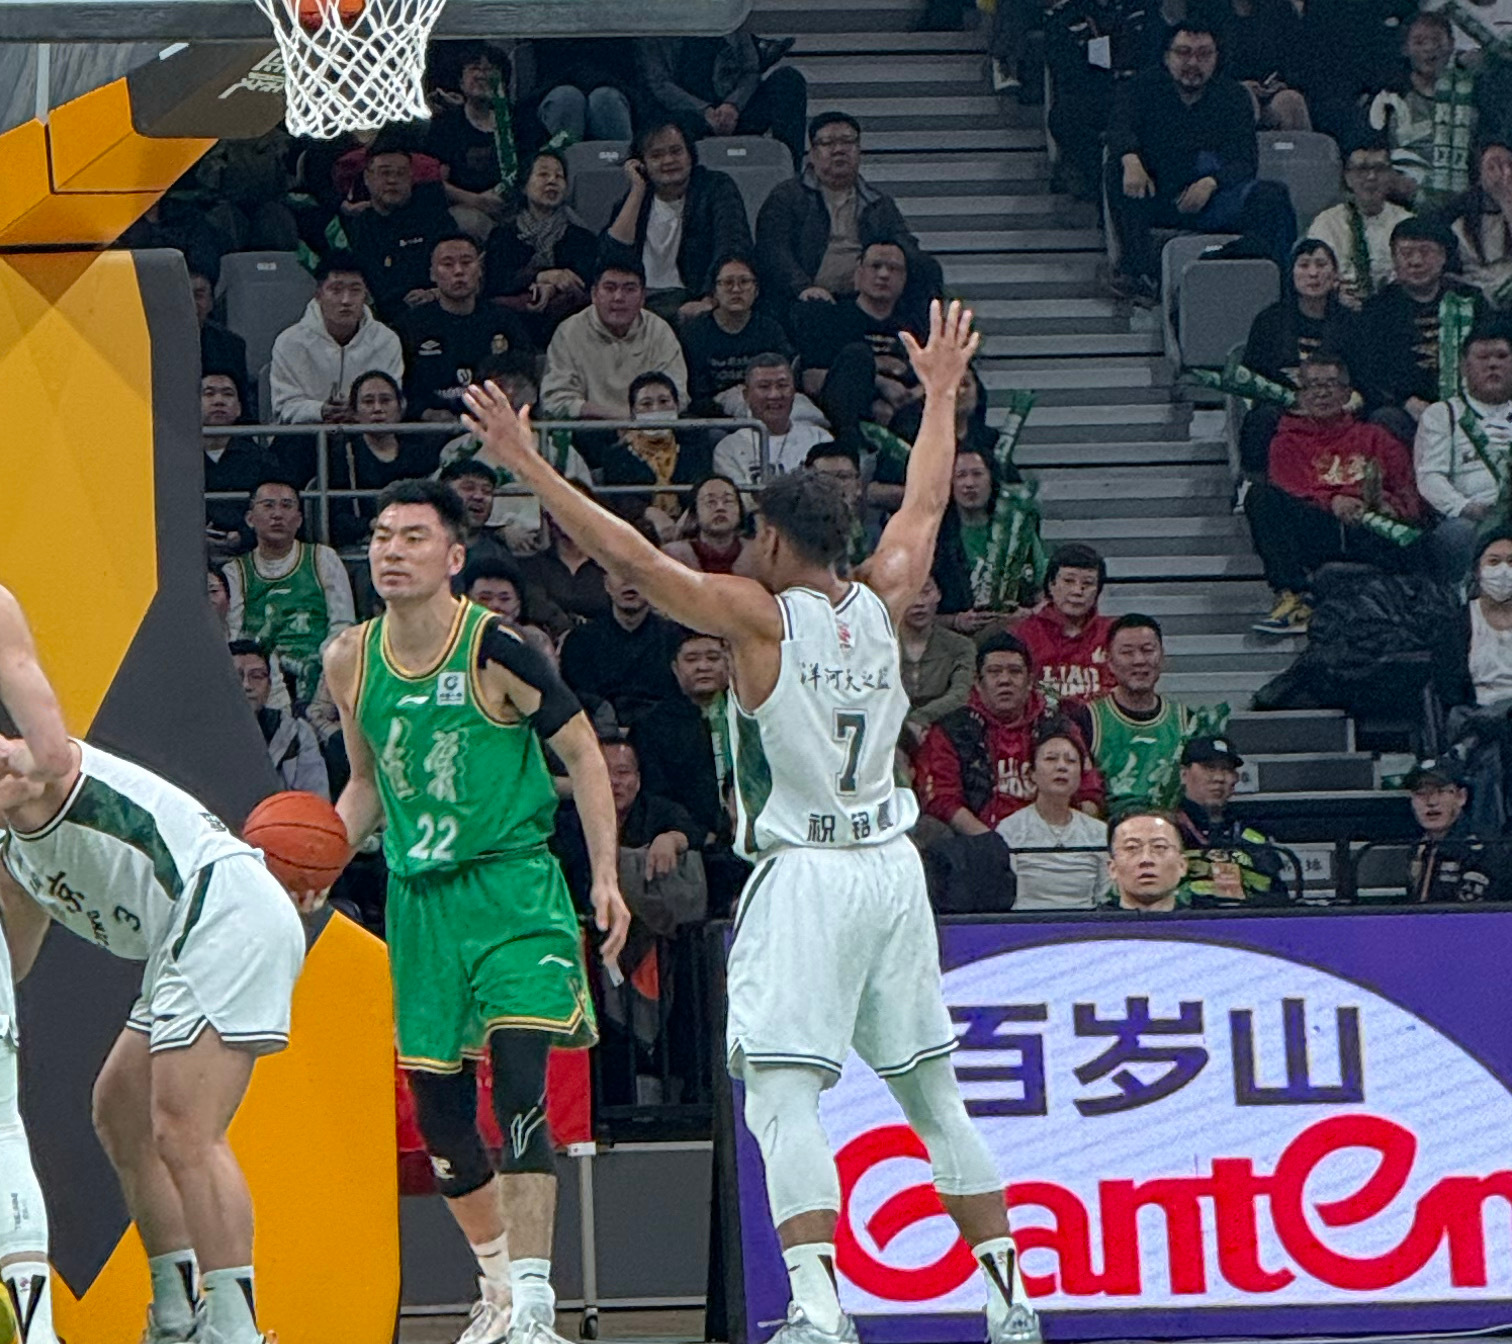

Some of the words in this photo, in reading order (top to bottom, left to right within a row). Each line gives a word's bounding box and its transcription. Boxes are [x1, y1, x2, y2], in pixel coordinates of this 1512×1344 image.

[834, 709, 868, 795] 7
[407, 813, 458, 860] 22
[950, 997, 1366, 1117] 百岁山
